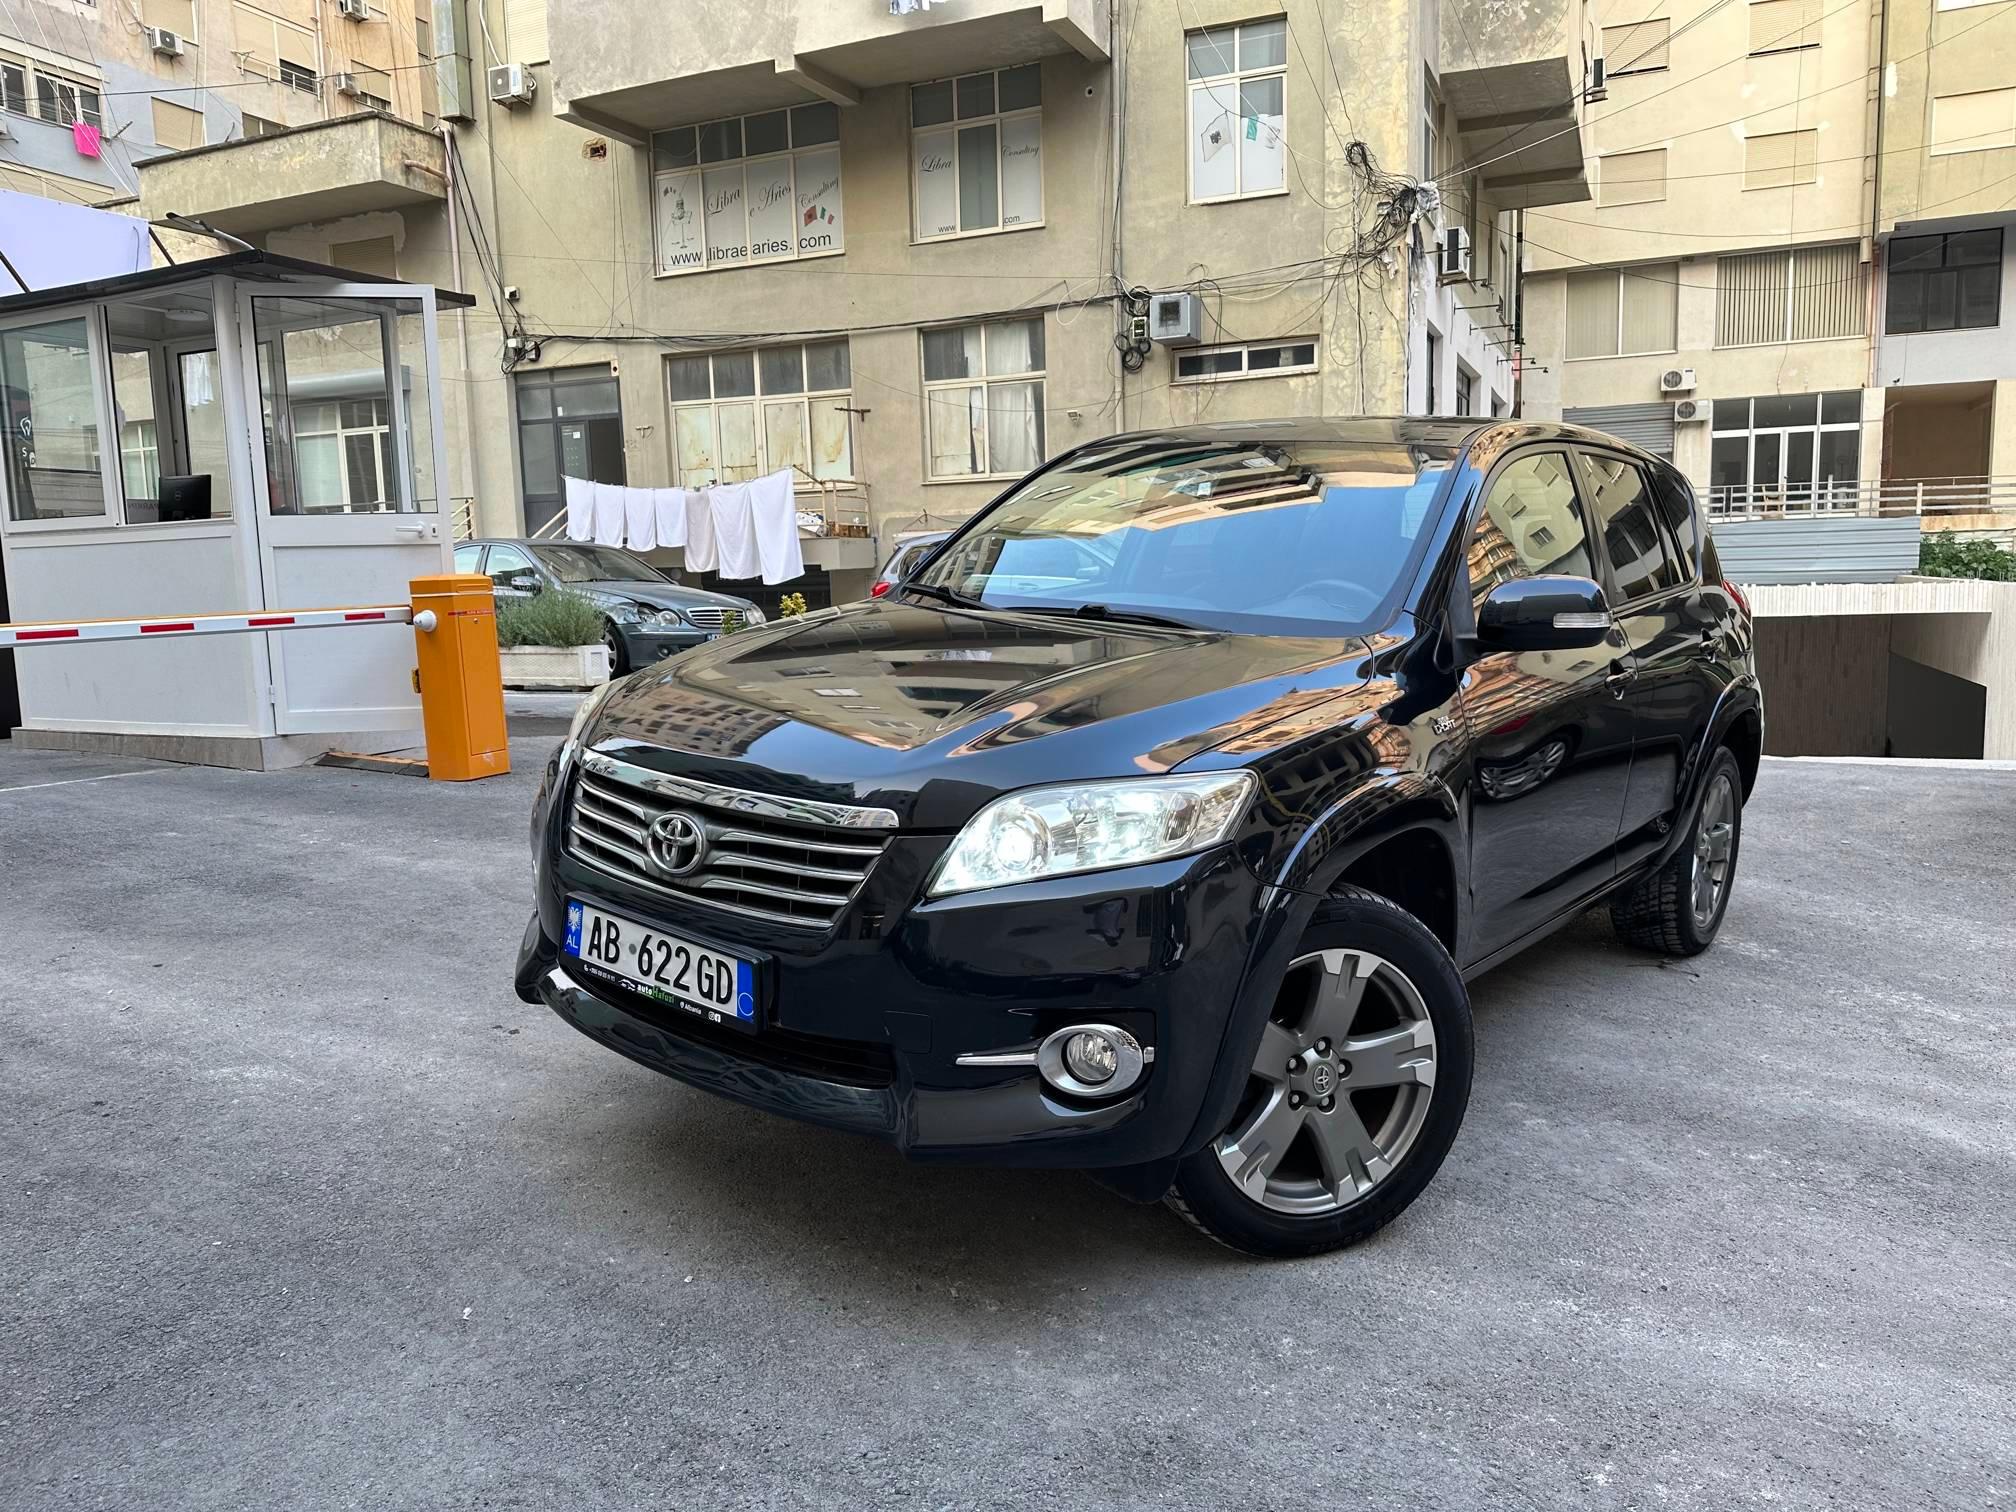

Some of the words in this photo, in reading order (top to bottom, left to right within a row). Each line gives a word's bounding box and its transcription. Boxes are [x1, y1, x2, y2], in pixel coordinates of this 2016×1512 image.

[920, 154, 952, 172] Libra
[1001, 144, 1039, 158] Consulting
[706, 188, 740, 216] Libra
[757, 181, 792, 211] Aries
[798, 176, 839, 208] Consulting
[565, 933, 579, 949] AL
[587, 915, 621, 964] AB
